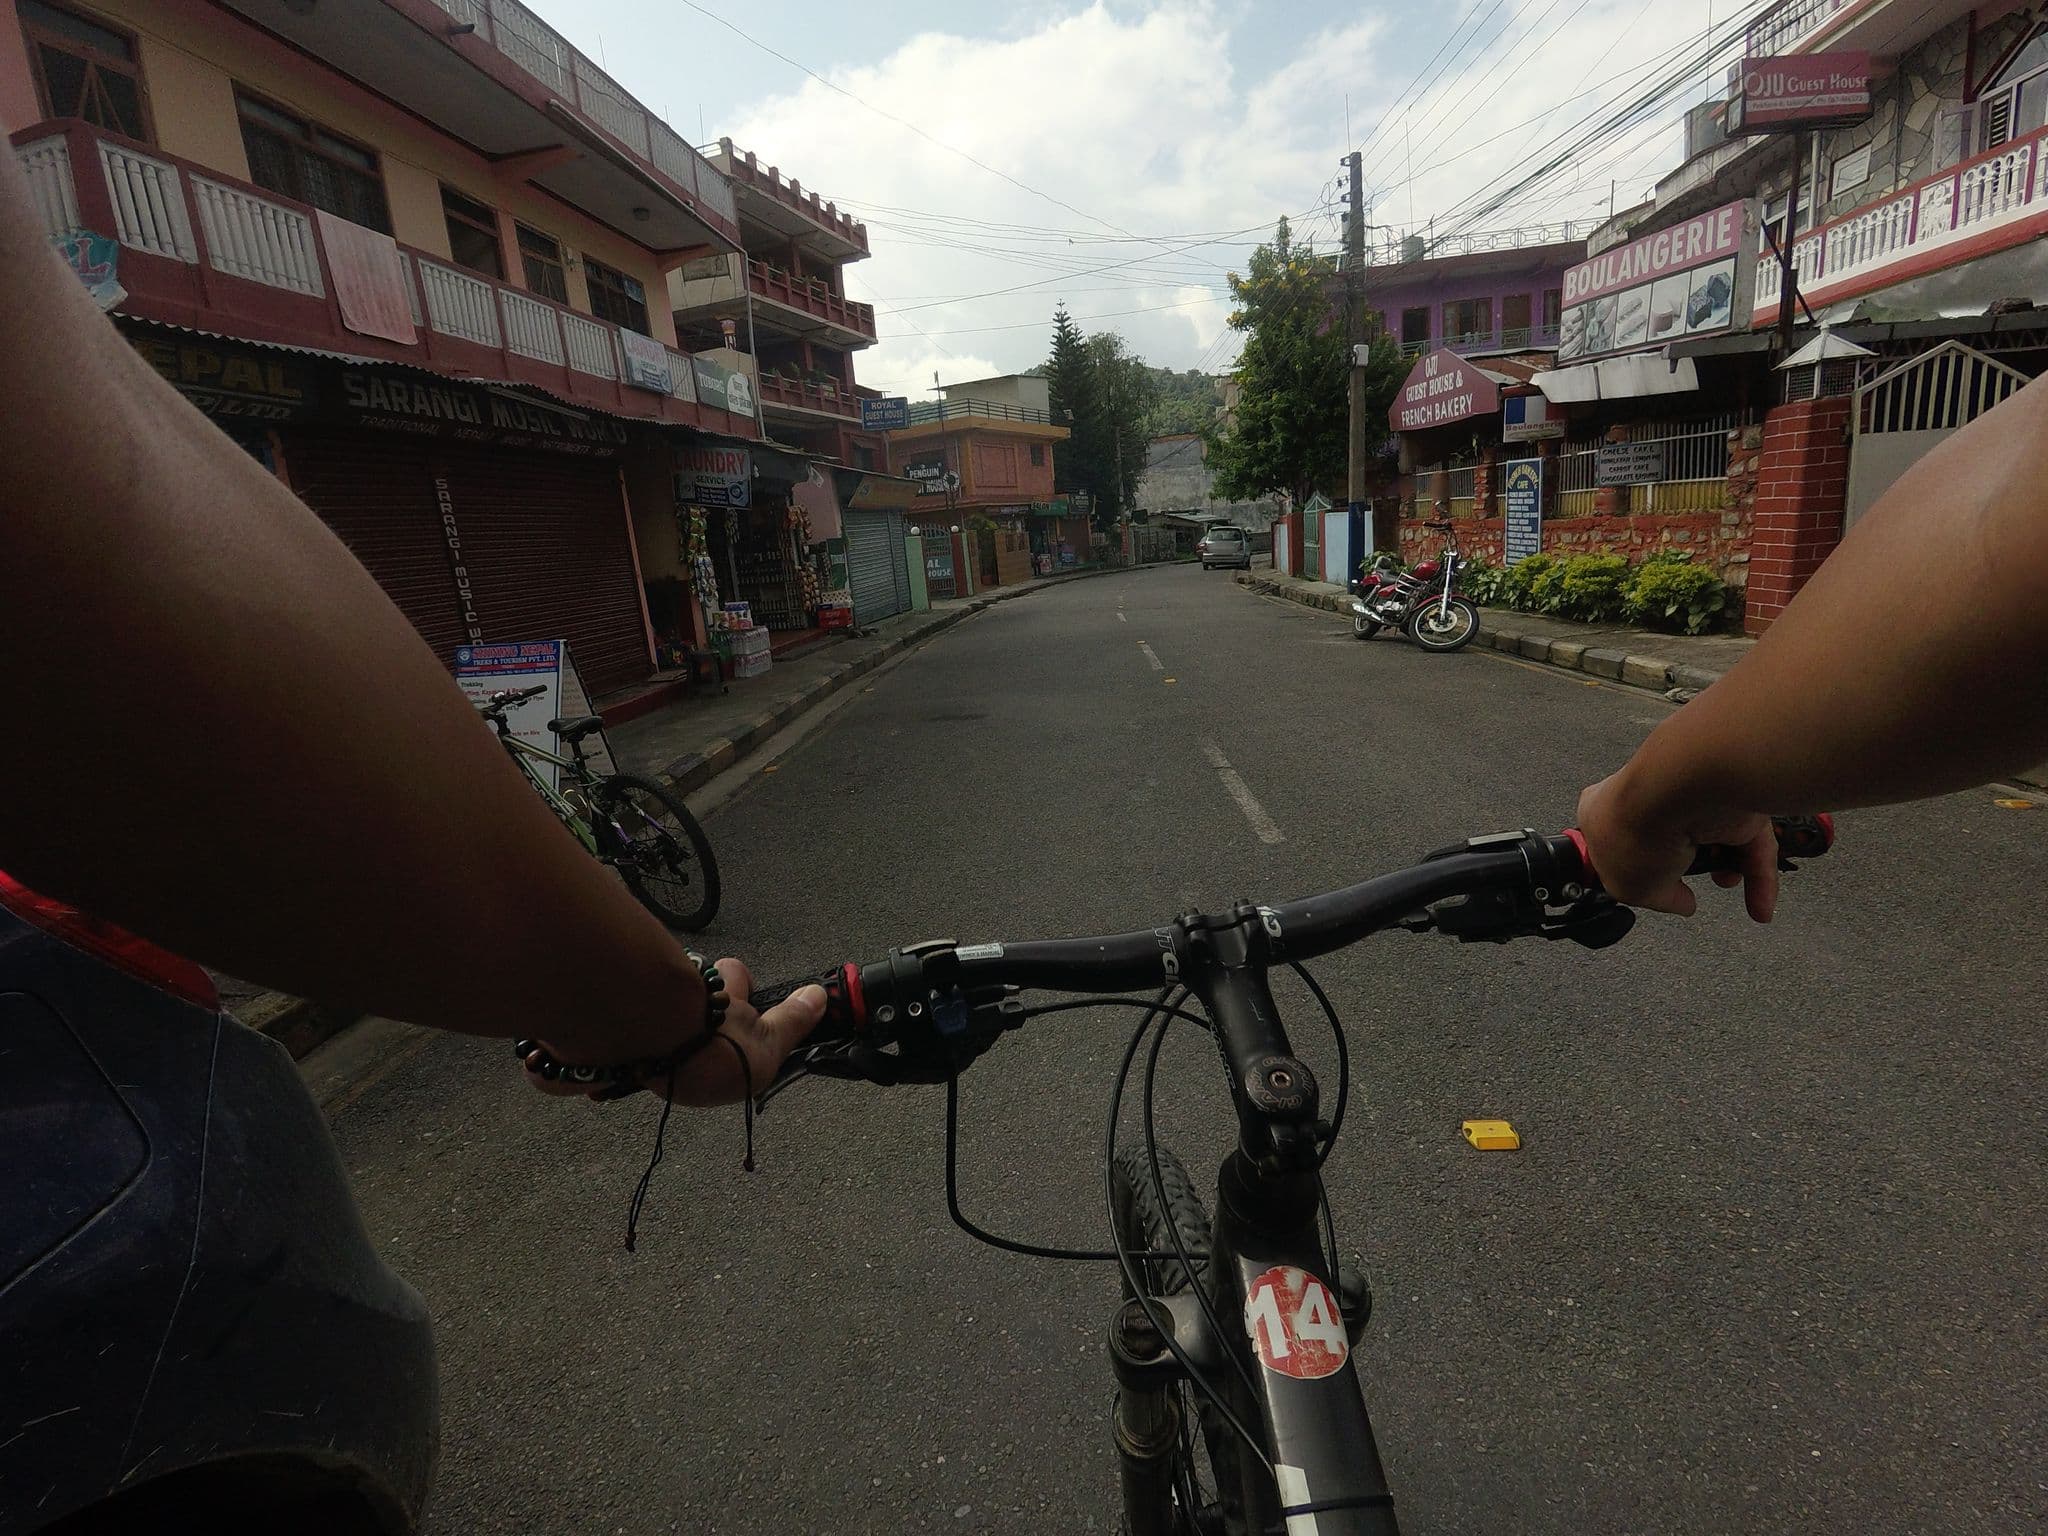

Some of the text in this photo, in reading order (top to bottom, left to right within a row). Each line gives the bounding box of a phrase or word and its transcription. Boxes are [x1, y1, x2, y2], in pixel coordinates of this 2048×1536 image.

[1744, 72, 1784, 97] OJU
[1565, 208, 1733, 300] BOULANGERIE
[136, 341, 304, 400] EPAL
[1425, 355, 1438, 378] OJU
[1406, 370, 1463, 402] GUEST HOUSE &
[343, 372, 482, 425] SARANGI
[490, 398, 561, 436] MUSIC
[871, 401, 897, 410] ROYAL
[1401, 393, 1473, 427] FRENCH BAKERY
[672, 448, 745, 475] LAUNDRY
[909, 467, 939, 479] PENGUIN
[696, 475, 726, 485] SERVICE
[435, 479, 461, 561] SARANGI
[520, 643, 556, 657] NEPAL
[1246, 1281, 1347, 1359] 14
